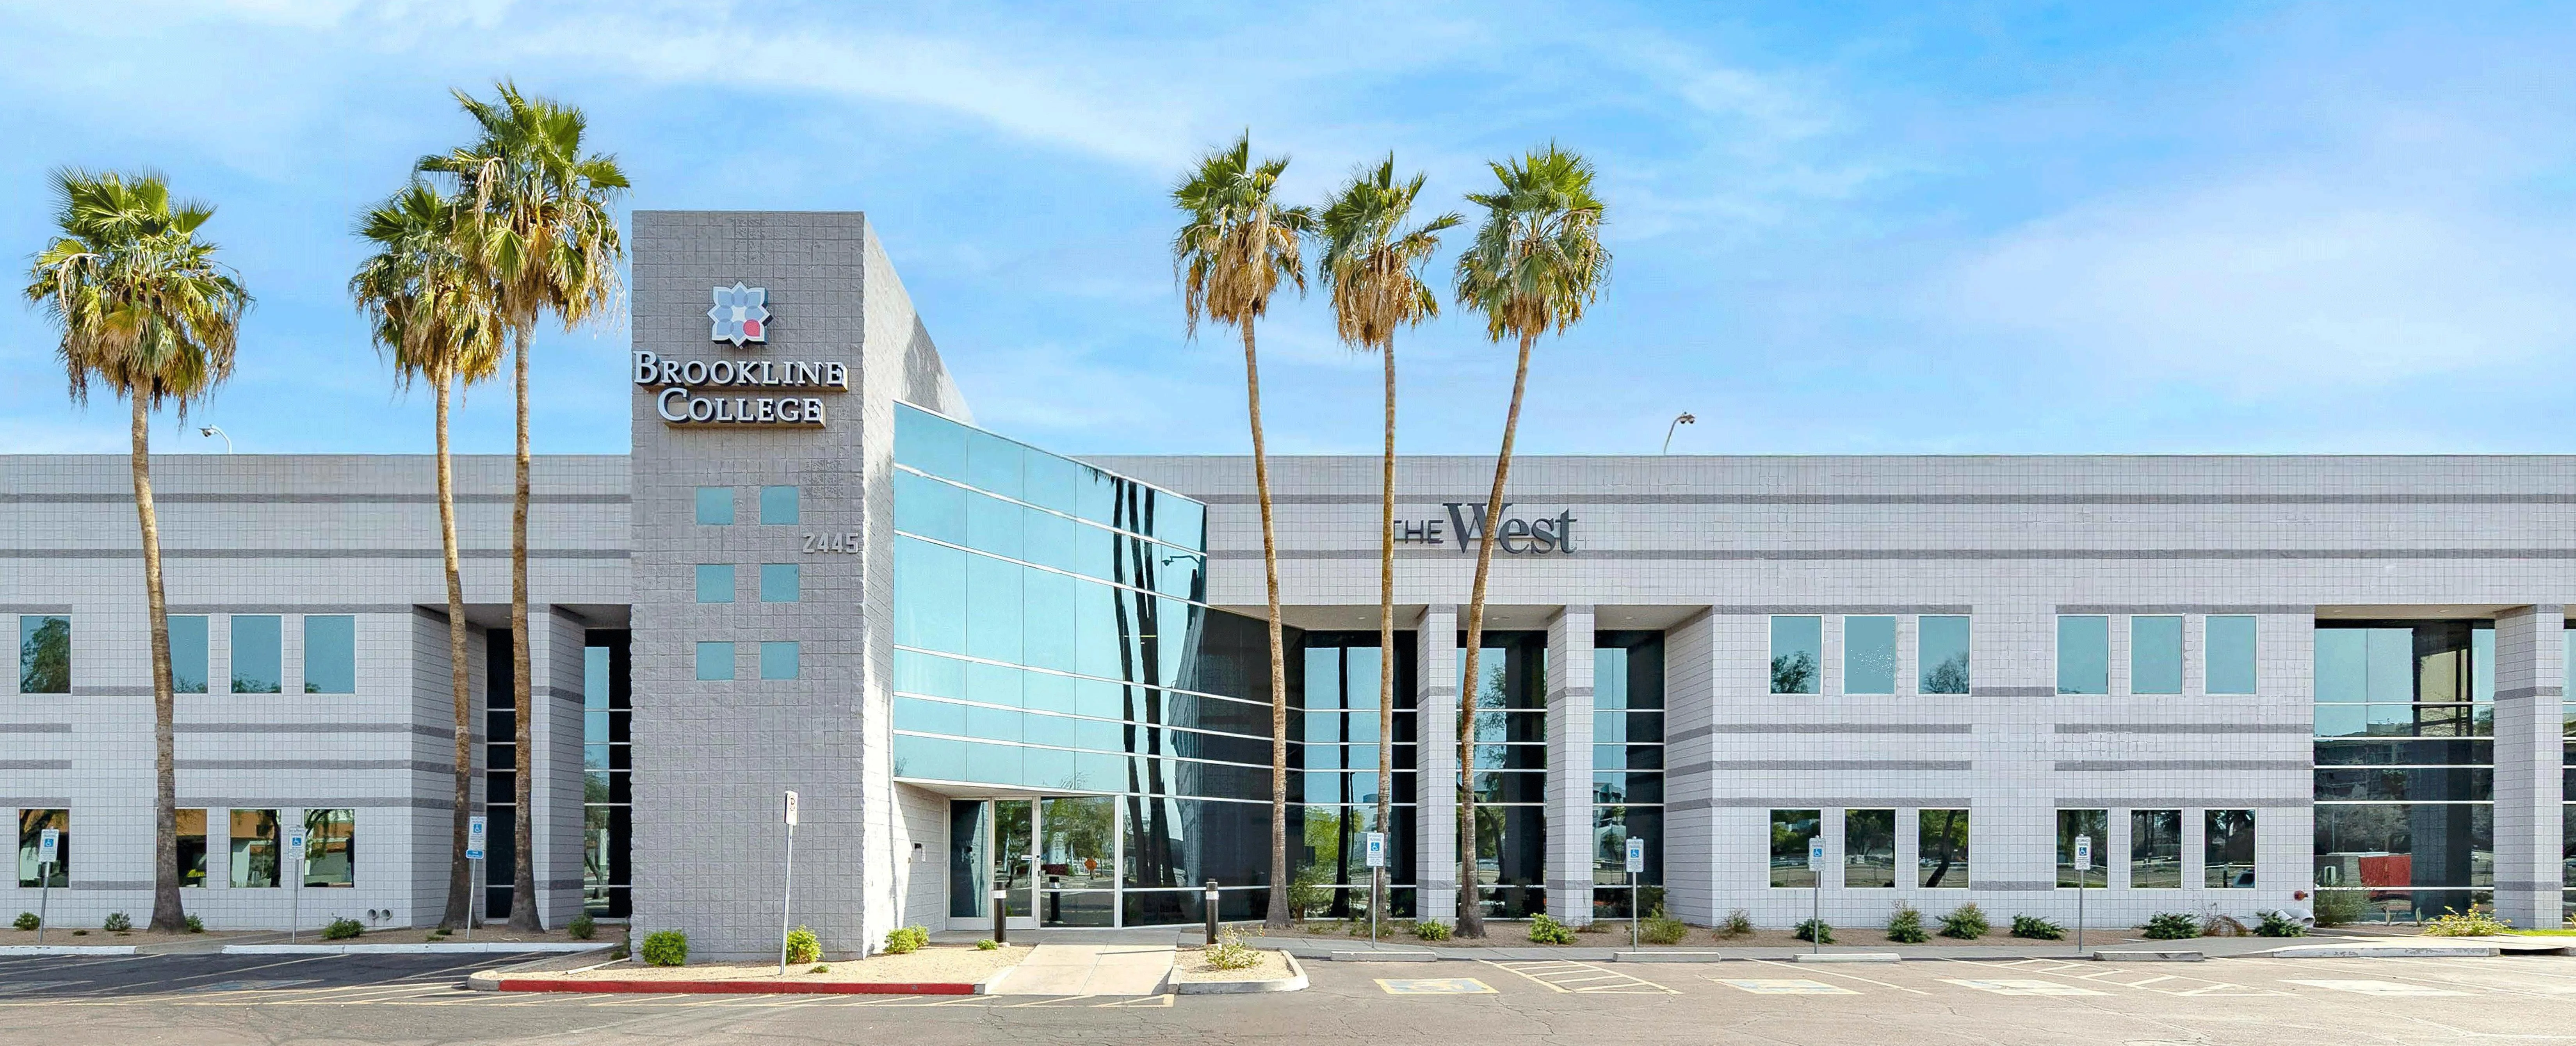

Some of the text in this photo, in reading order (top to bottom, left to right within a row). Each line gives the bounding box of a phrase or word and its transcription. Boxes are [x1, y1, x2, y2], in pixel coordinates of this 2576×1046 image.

[633, 350, 845, 385] BROOKLINE
[657, 387, 823, 422] COLLEGE
[803, 532, 858, 554] 2445
[1443, 503, 1577, 554] West
